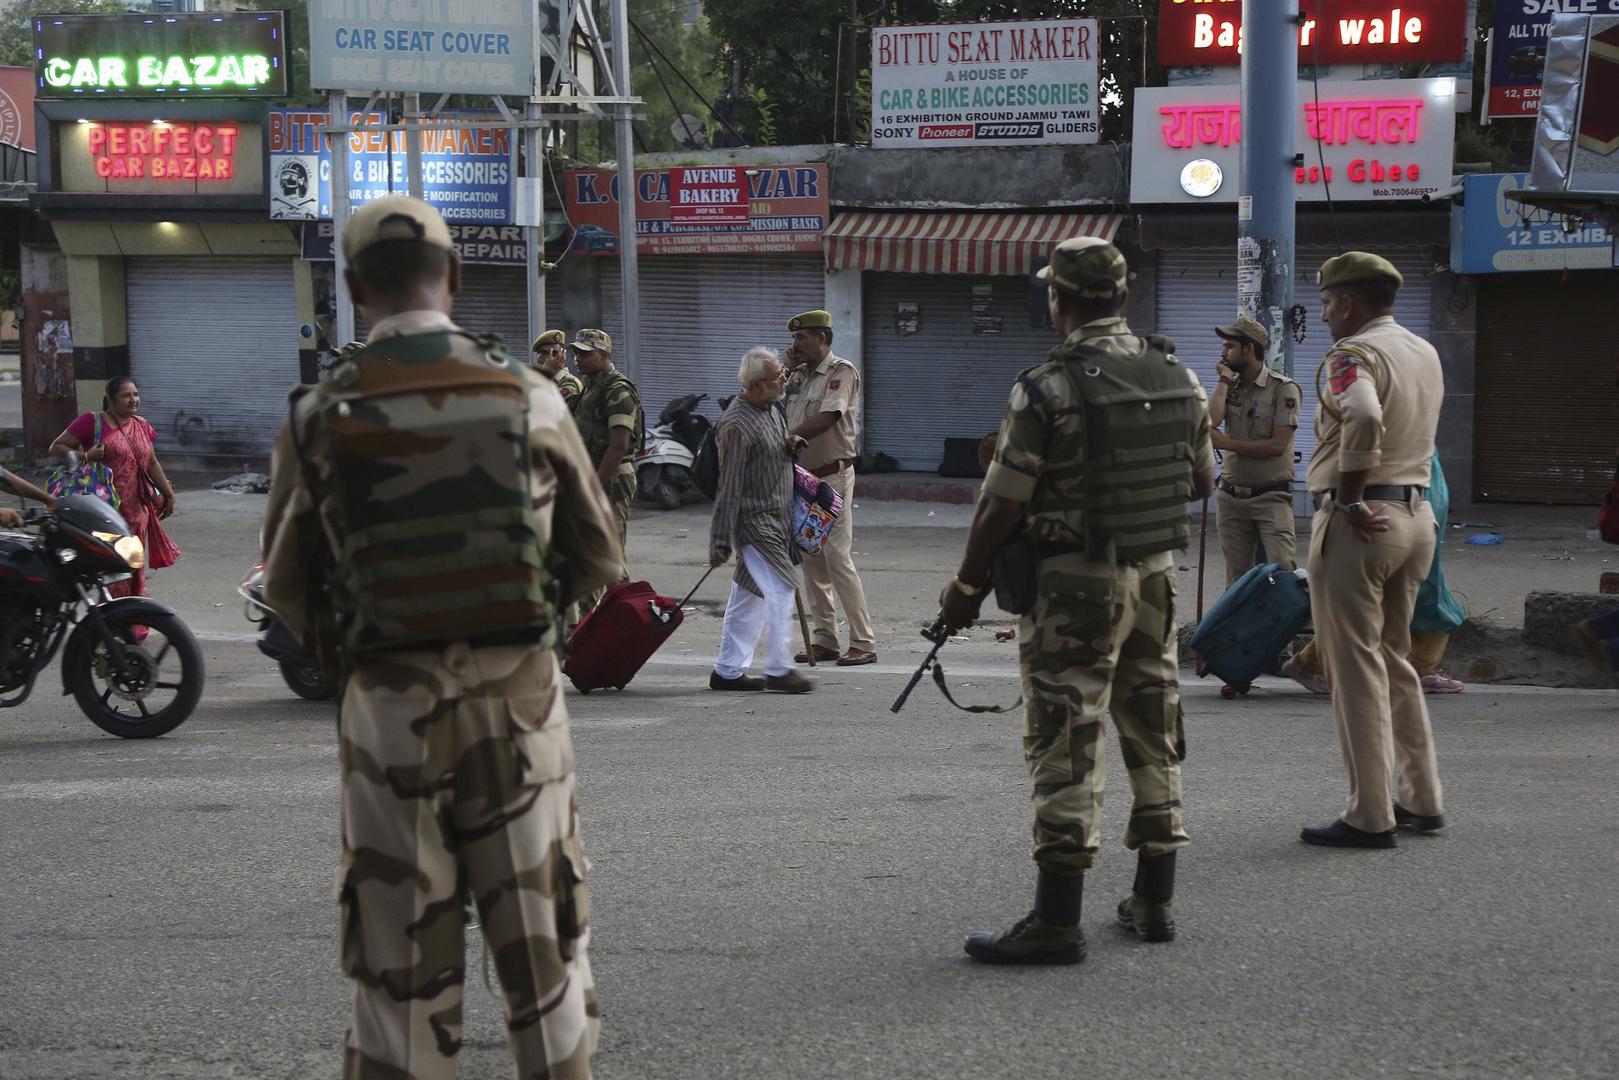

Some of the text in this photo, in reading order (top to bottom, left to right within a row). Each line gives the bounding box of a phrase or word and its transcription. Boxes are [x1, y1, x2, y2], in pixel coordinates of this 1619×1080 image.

[1339, 9, 1422, 45] wale
[1508, 24, 1529, 38] ALL
[335, 28, 511, 55] CAR SEAT COVER
[879, 26, 1091, 66] BITTU SEAT MAKER
[45, 54, 270, 87] CAR BAZAR
[945, 68, 1029, 82] A HOUSE OF
[880, 83, 1090, 110] CAR & BIKE ACCESSORIES
[896, 113, 962, 124] EXHIBITION
[965, 112, 1014, 122] GROUND
[1015, 111, 1058, 121] JAMMU
[1062, 110, 1091, 119] TAWI
[1303, 99, 1424, 145] चावल
[874, 122, 1097, 139] SONY Pioneer STUDDS GLIDERS
[89, 126, 238, 154] PERFECT
[96, 157, 232, 179] CAR BAZAR
[353, 159, 363, 183] &
[682, 168, 736, 184] AVENUE
[1347, 159, 1420, 183] Ghee
[430, 191, 498, 202] MODIFICATION
[679, 187, 740, 204] BAKERY
[321, 205, 328, 215] &
[441, 208, 506, 219] ACCESSORIES
[651, 221, 659, 233] &
[792, 217, 820, 230] BASIS
[1507, 230, 1532, 246] 12
